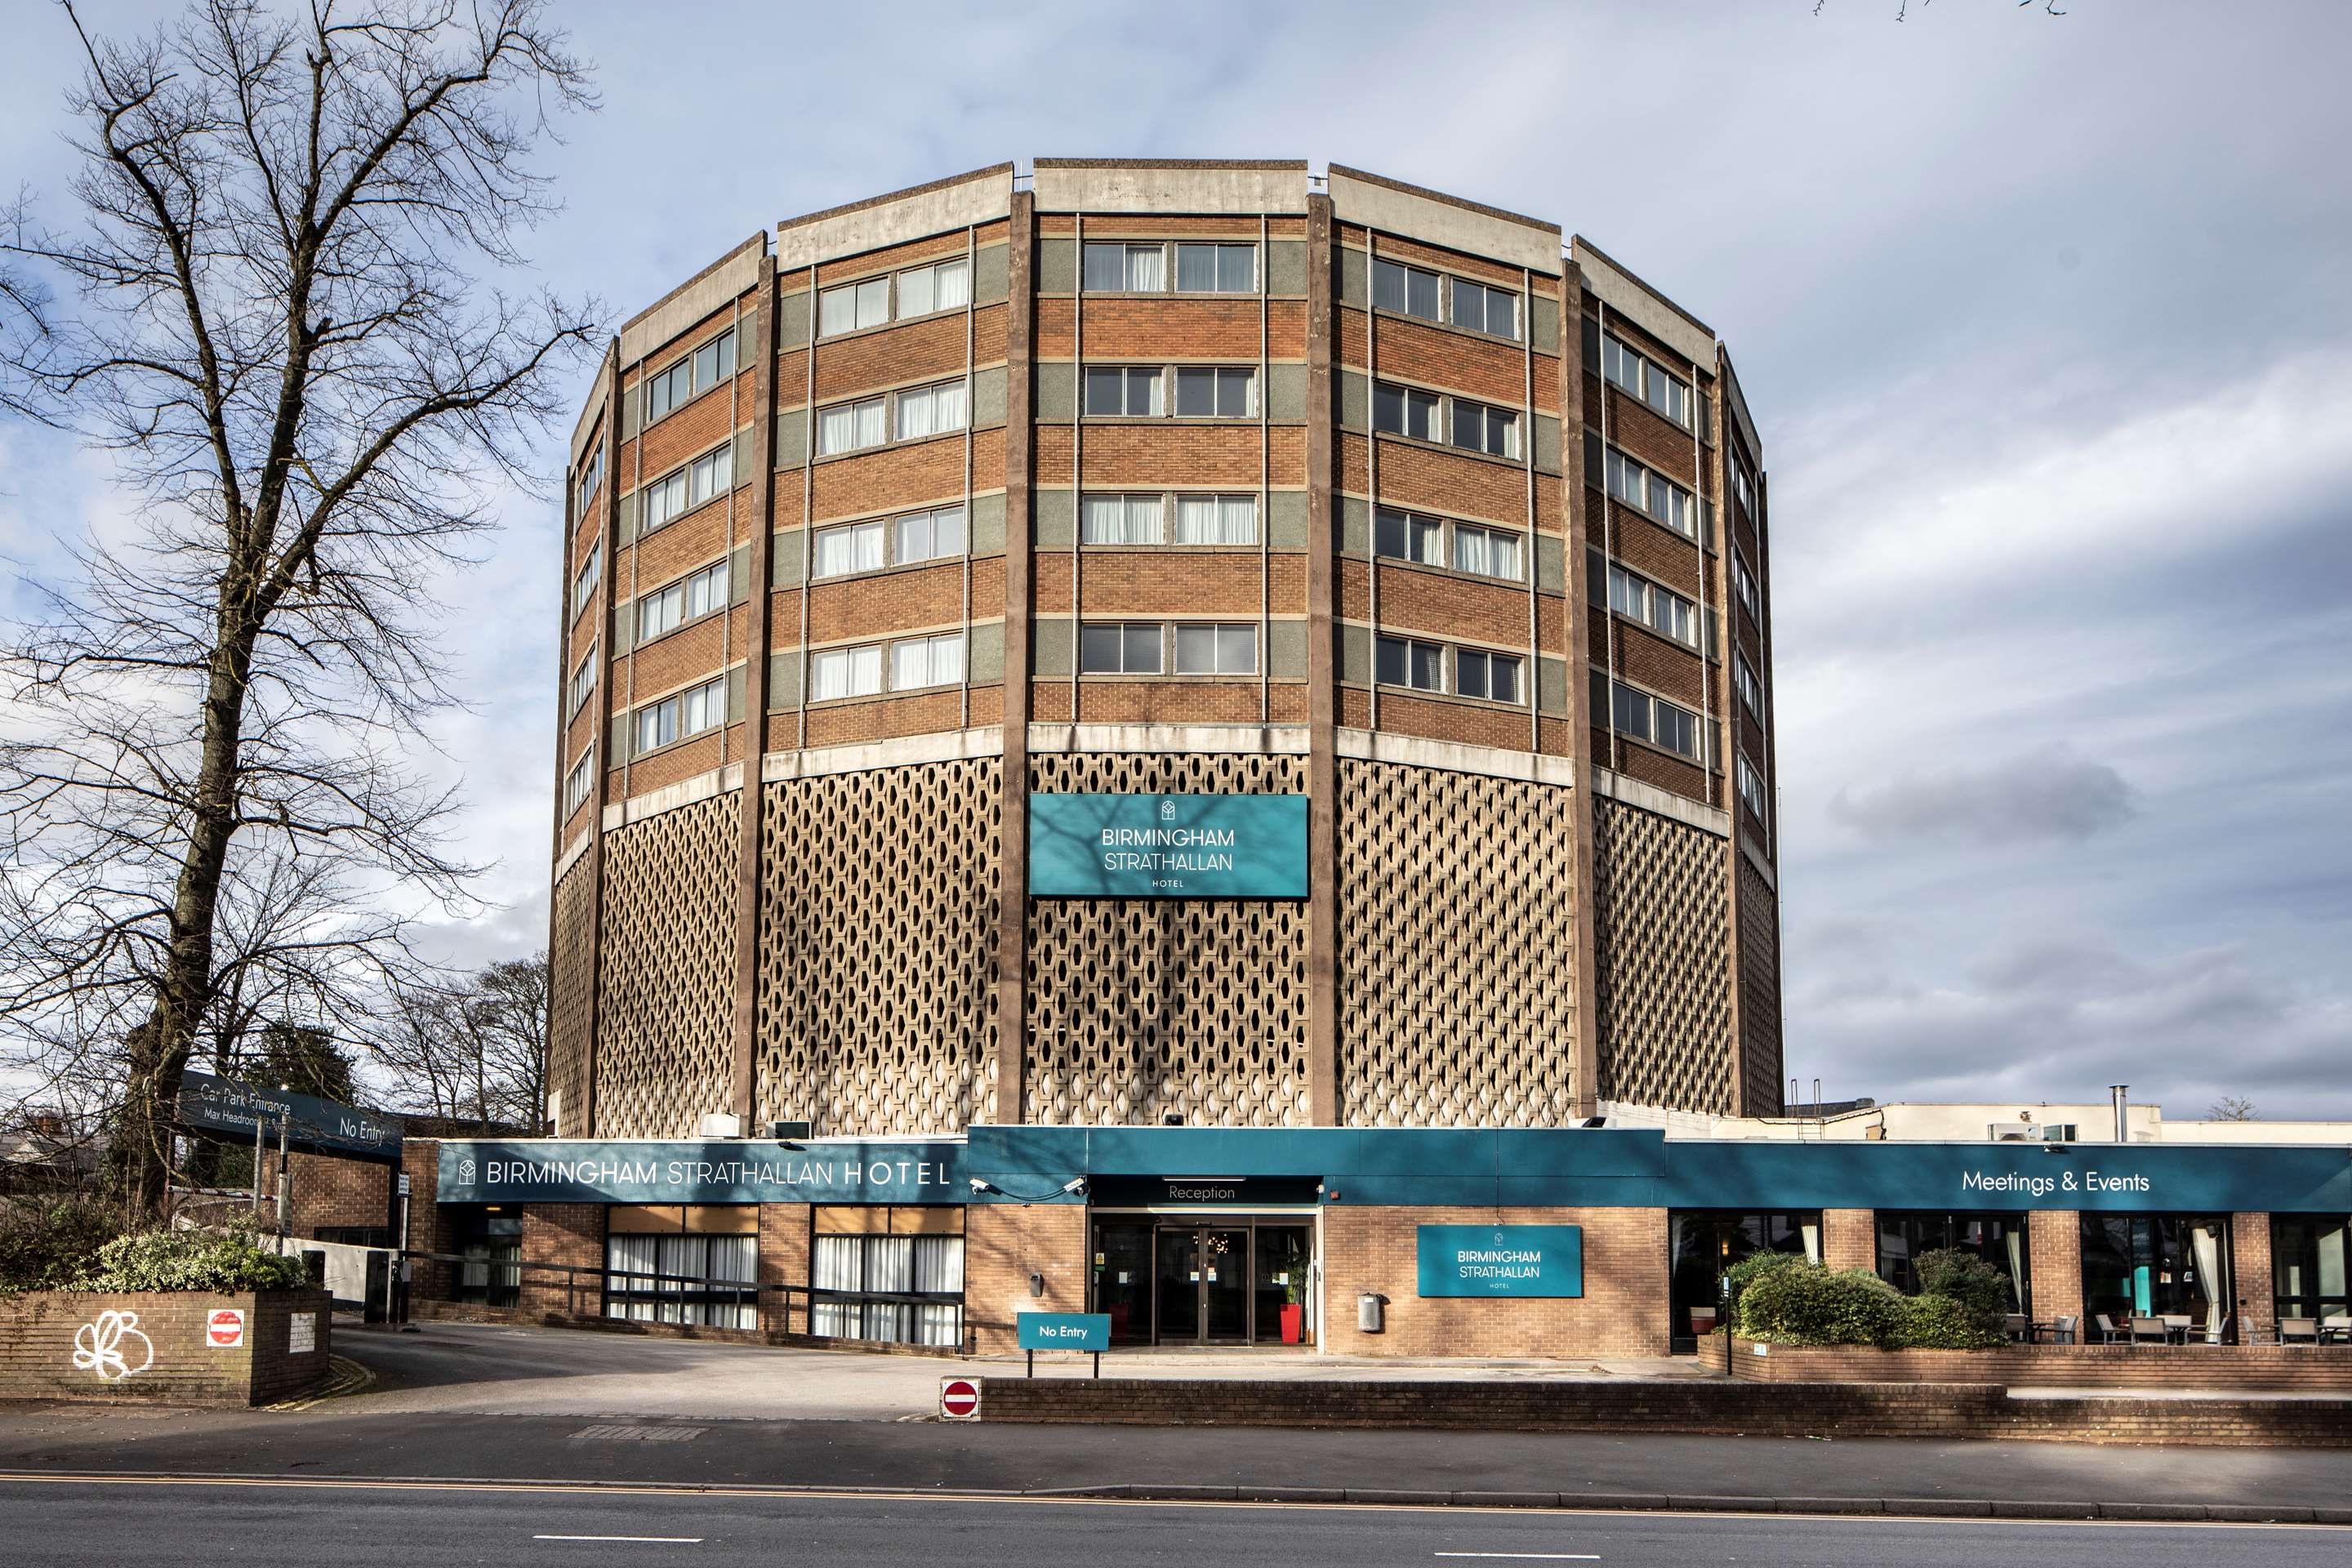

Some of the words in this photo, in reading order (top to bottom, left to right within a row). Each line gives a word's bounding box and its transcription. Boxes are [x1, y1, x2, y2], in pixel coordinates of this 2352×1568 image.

[1102, 829, 1234, 847] BIRMINGHAM
[1104, 853, 1232, 871] STRATHALLAN
[1152, 880, 1183, 888] HOTEL
[201, 1083, 220, 1102] Car
[223, 1088, 246, 1107] Park
[249, 1093, 291, 1116] Entrance
[204, 1107, 220, 1120] Max
[340, 1117, 357, 1138] No
[359, 1120, 385, 1147] Entry
[487, 1160, 657, 1184] BIRMINGHAM
[667, 1161, 832, 1185] STRATHALLAN
[844, 1161, 950, 1185] HOTEL
[1962, 1171, 2055, 1197] Meetings
[2061, 1171, 2078, 1192] &
[2086, 1171, 2150, 1192] Events
[1169, 1185, 1235, 1202] Reception
[1458, 1250, 1541, 1263] BIRMINGHAM
[1459, 1266, 1540, 1278] STRATHALLAN
[1040, 1325, 1057, 1337] No
[1060, 1325, 1088, 1339] Entry
